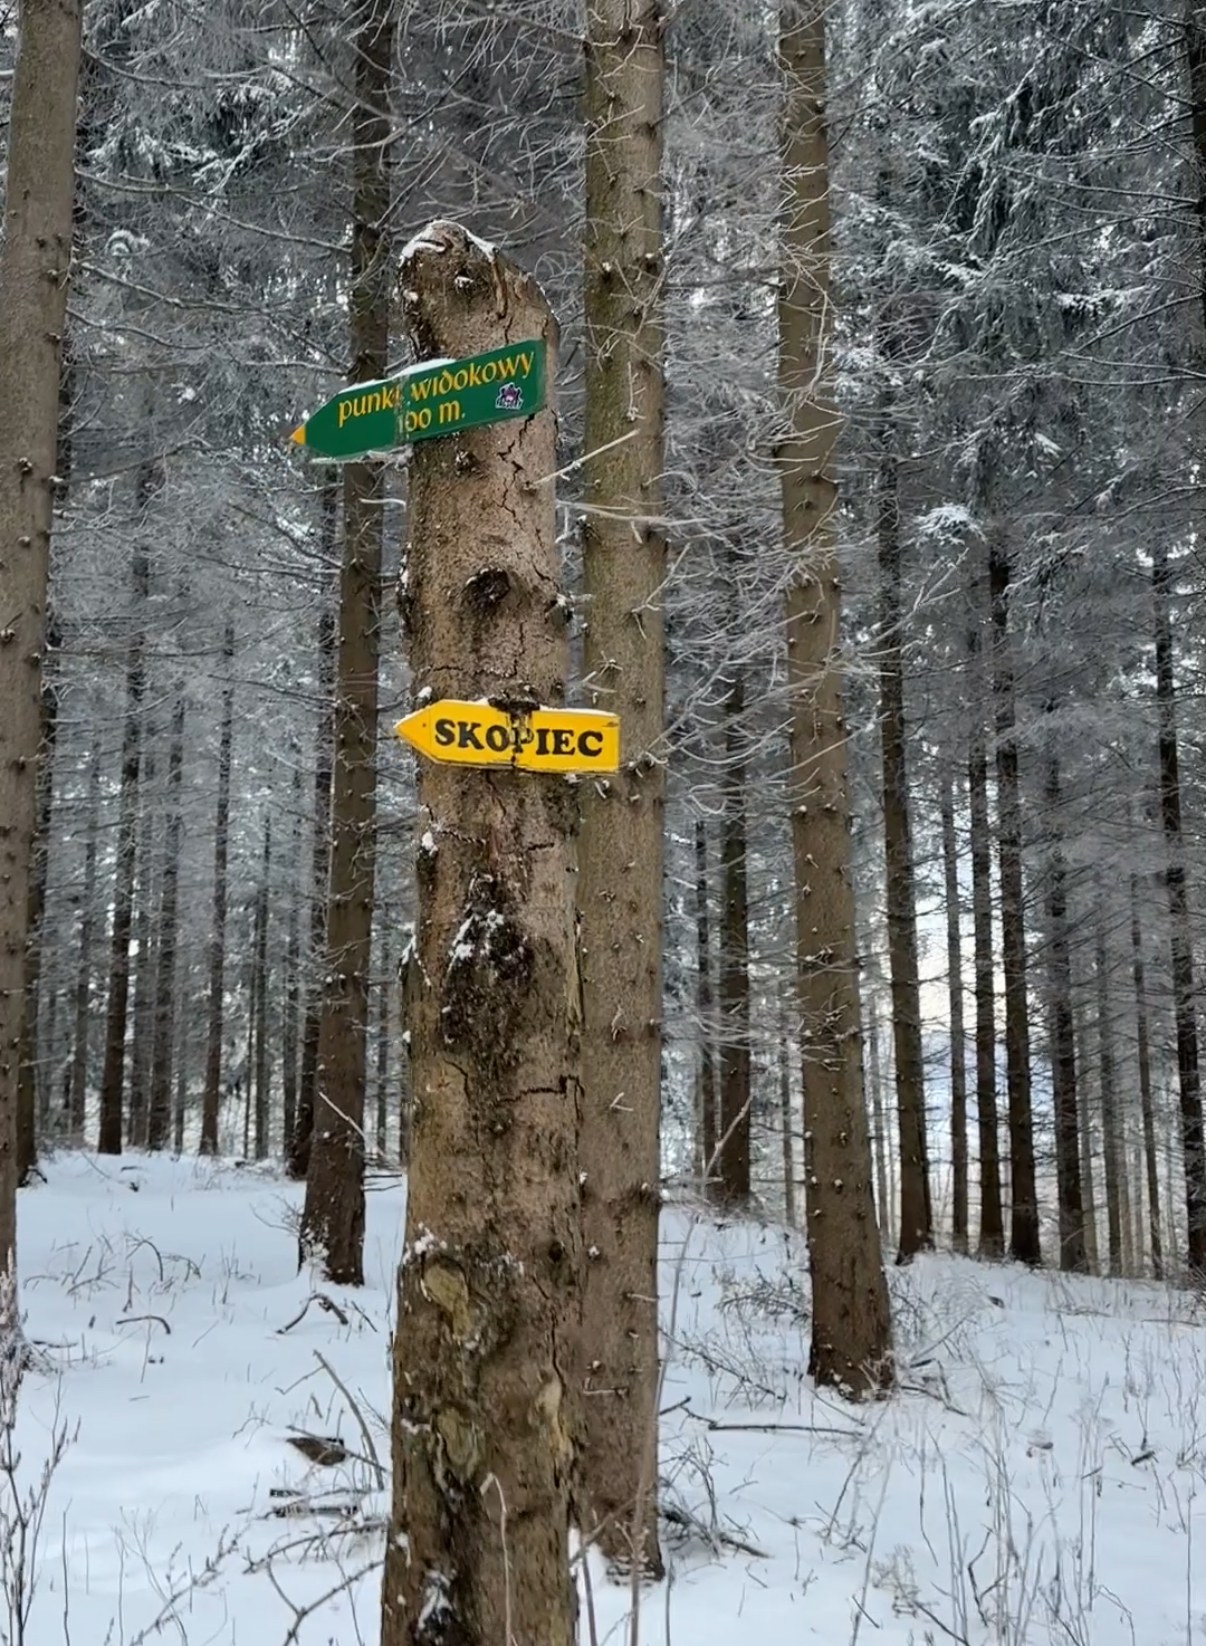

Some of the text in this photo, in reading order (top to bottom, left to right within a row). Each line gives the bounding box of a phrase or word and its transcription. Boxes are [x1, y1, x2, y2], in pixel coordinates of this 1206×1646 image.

[410, 351, 535, 402] widokowy
[439, 400, 466, 424] m.
[435, 719, 604, 757] SKOPIEC
